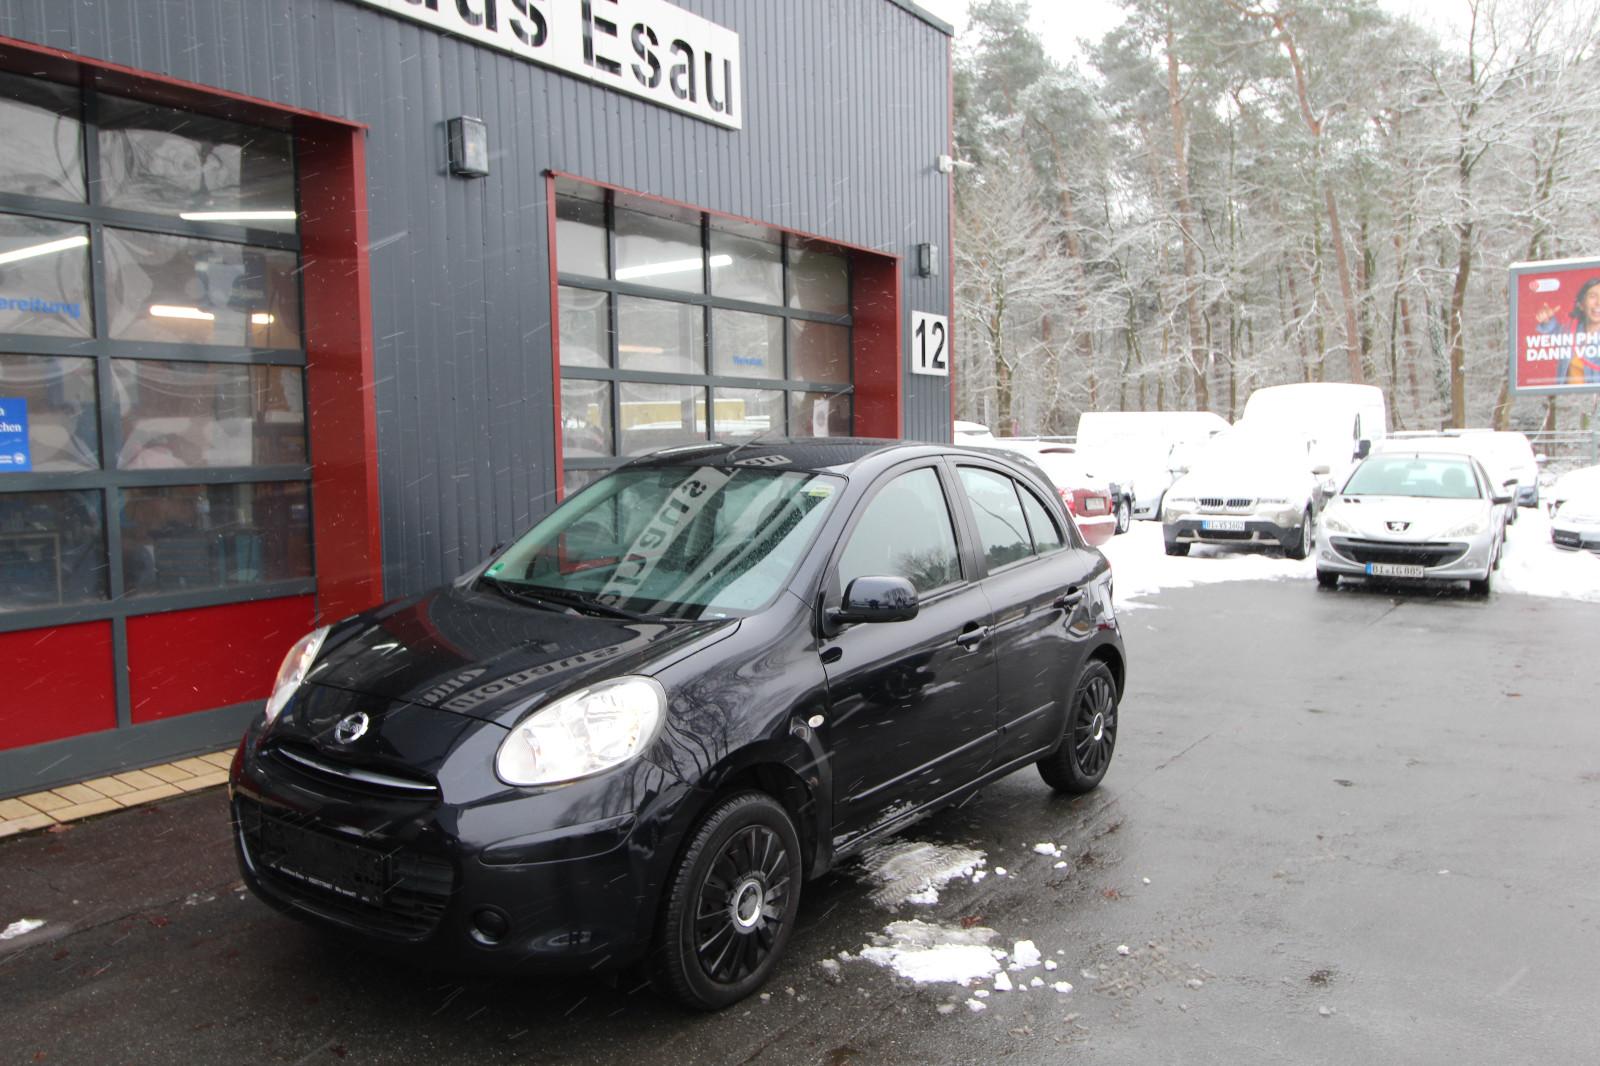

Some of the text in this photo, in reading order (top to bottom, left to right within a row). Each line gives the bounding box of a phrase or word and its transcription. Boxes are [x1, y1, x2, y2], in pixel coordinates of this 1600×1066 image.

[581, 0, 733, 116] Esau
[916, 319, 946, 370] 12
[1526, 331, 1600, 348] WENN PH
[1526, 345, 1600, 361] DANN VO
